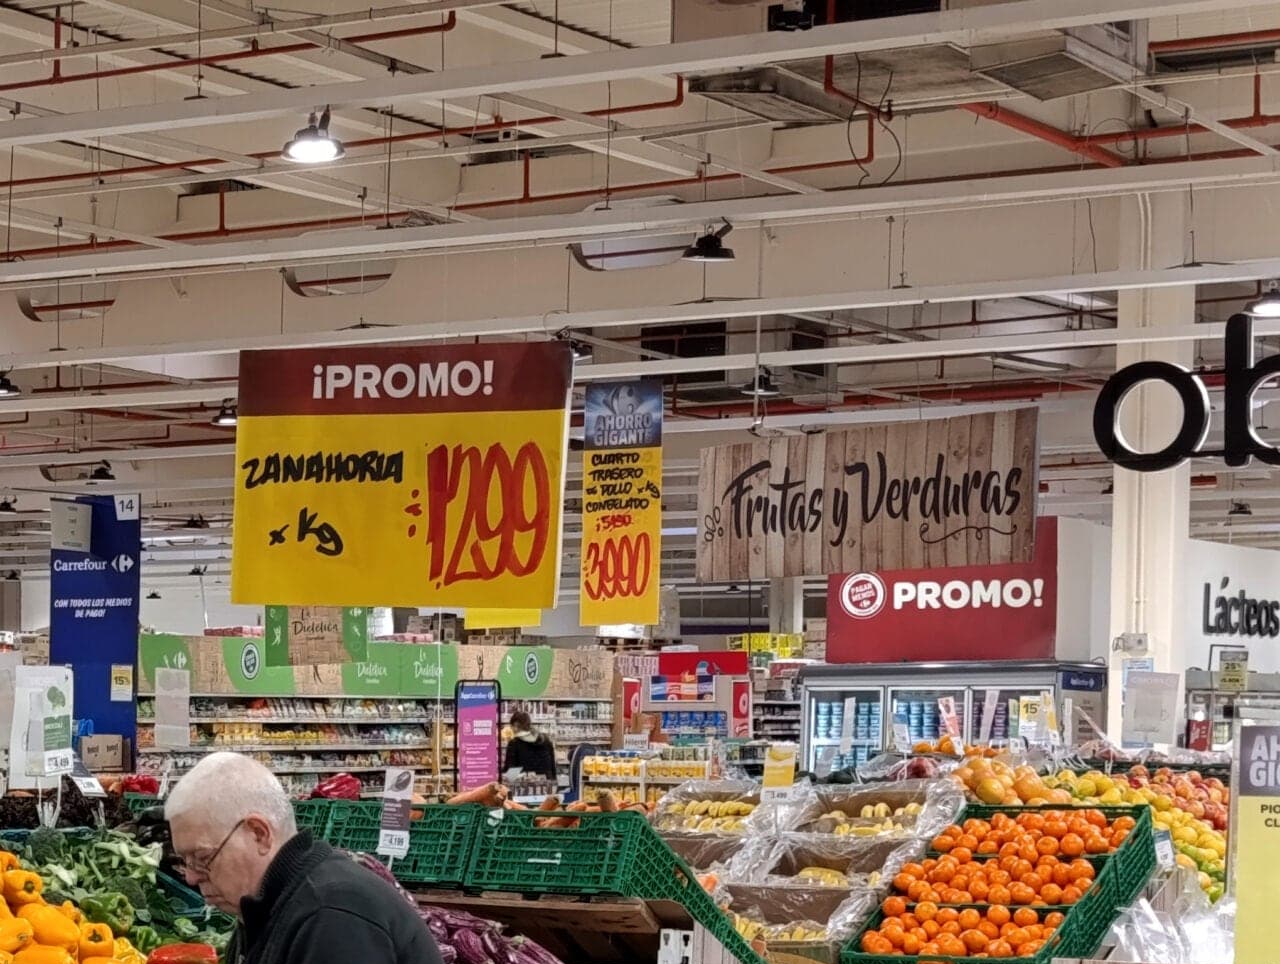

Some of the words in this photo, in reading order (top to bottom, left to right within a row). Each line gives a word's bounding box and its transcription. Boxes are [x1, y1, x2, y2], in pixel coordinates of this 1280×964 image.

[312, 360, 494, 400] ¡PROMO!
[595, 414, 653, 431] AHORRO
[594, 429, 653, 446] GIGANTE
[591, 452, 640, 466] CUARTO
[242, 450, 404, 489] ZANAHORIA
[590, 467, 643, 481] TRASERO
[600, 482, 632, 496] POLLO
[119, 499, 135, 513] 14
[586, 498, 649, 513] CONGELADO
[722, 460, 823, 539] Frutas
[830, 487, 849, 547] y
[845, 451, 1022, 524] Verduras
[53, 558, 108, 572] Carrefour
[893, 579, 1044, 609] PROMO!
[54, 599, 68, 608] CON
[70, 599, 90, 608] TODOS
[92, 599, 104, 607] LOS
[105, 598, 133, 607] MEDIOS
[1203, 576, 1280, 638] Lácteos
[74, 609, 84, 618] DE
